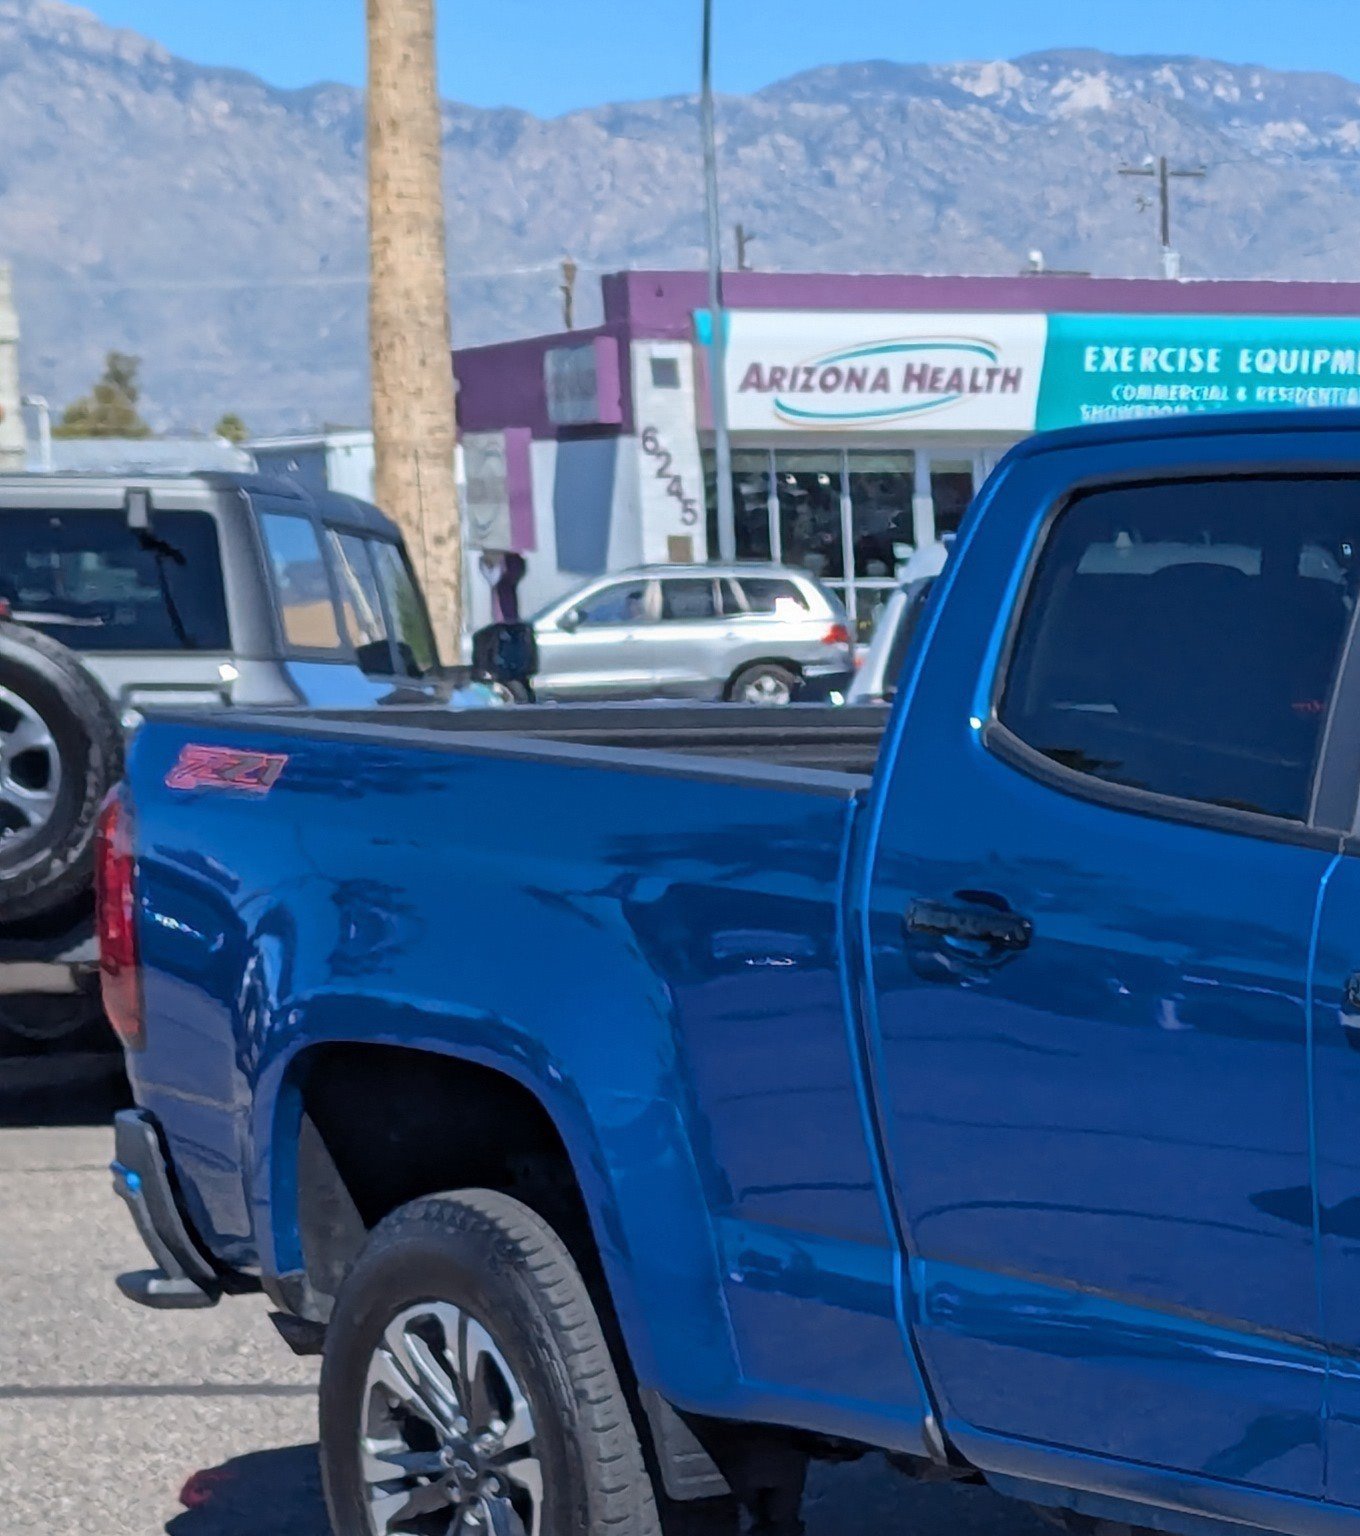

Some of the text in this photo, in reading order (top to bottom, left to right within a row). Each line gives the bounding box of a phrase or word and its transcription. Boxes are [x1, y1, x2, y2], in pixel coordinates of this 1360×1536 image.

[1083, 346, 1222, 373] EXERCISE
[738, 361, 1024, 394] ARIZONA HEALTH
[1111, 383, 1229, 402] COMMERCIAL
[641, 425, 698, 526] 6245
